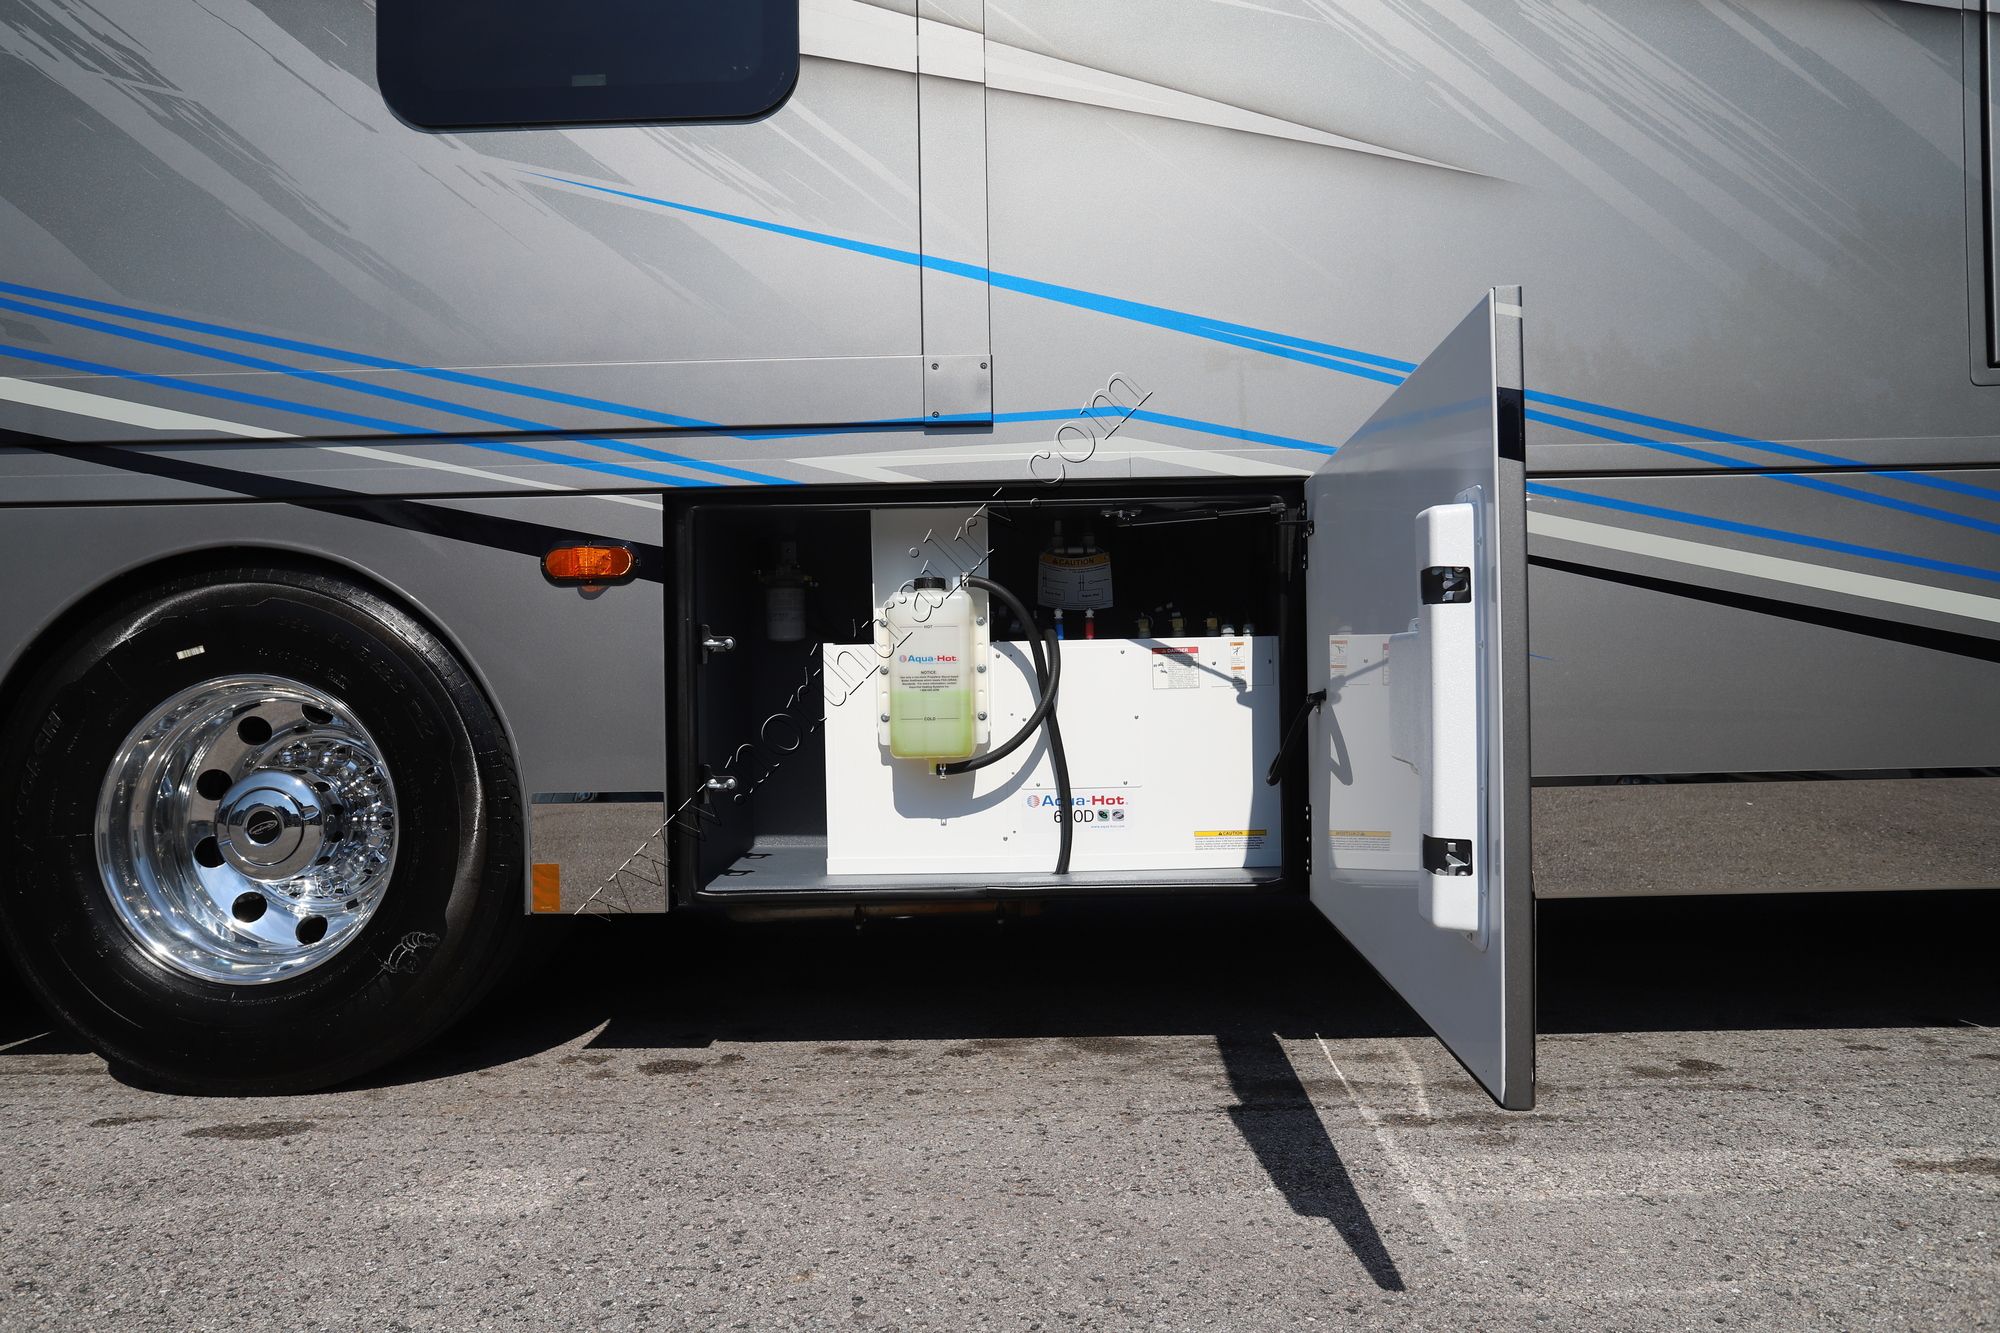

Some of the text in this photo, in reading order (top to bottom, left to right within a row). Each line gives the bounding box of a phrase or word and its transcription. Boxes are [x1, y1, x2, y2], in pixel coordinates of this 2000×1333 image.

[1060, 557, 1095, 566] CAUTION
[908, 655, 957, 664] Aqua-Hot
[1054, 809, 1094, 823] 60D
